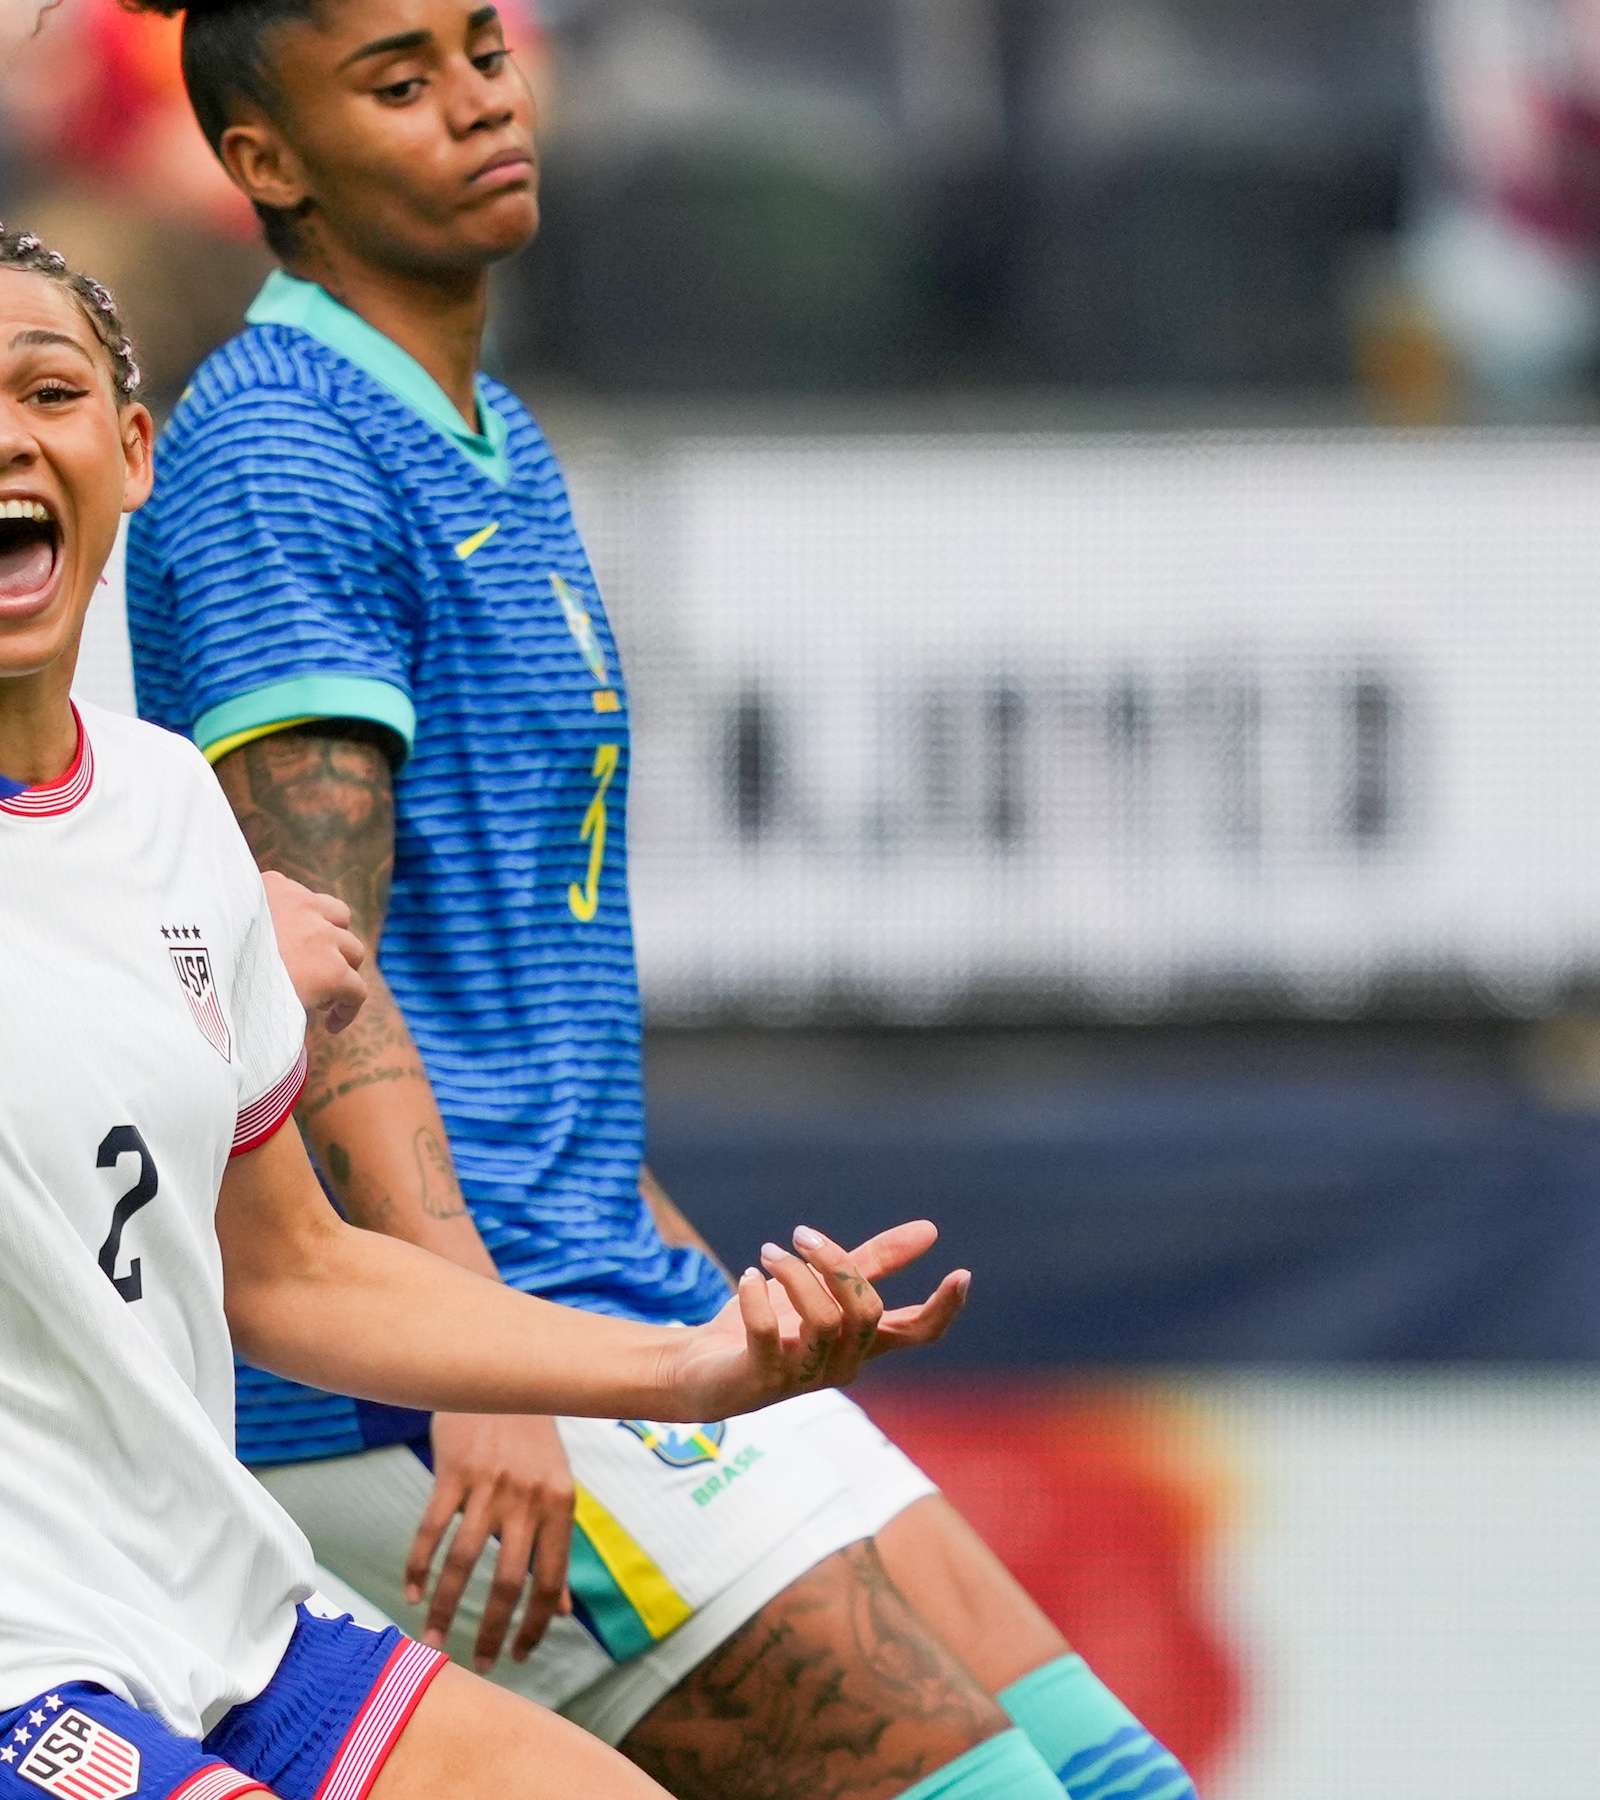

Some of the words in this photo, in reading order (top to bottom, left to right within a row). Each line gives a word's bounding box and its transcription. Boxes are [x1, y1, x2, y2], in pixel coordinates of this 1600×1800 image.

[567, 743, 620, 922] 3
[173, 955, 210, 999] USA
[95, 1124, 159, 1304] 2
[25, 1714, 93, 1781] USA
